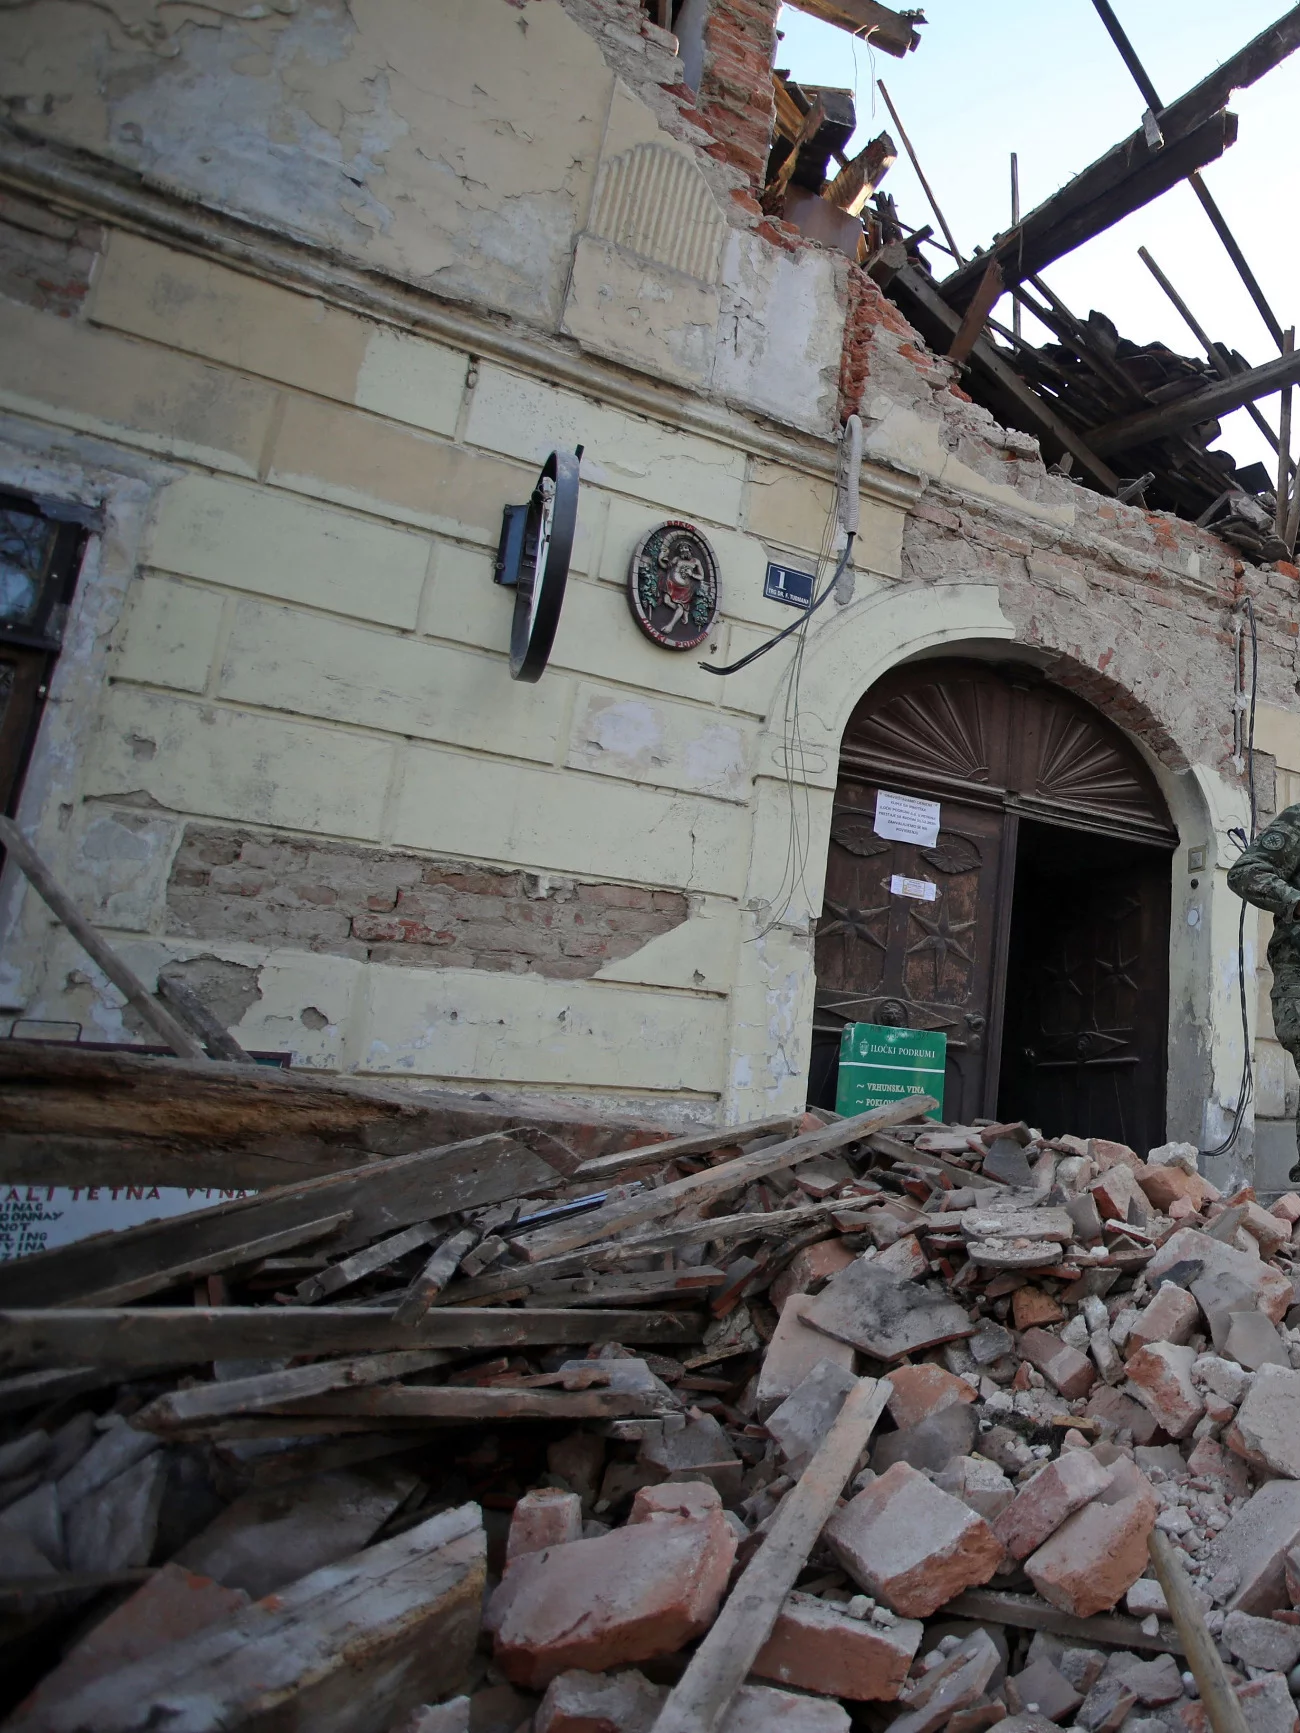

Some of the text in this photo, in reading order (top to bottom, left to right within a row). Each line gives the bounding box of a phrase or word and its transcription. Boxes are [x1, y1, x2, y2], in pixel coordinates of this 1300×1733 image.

[775, 570, 787, 591] 1
[768, 587, 777, 596] TRG
[871, 1044, 936, 1059] ILOČKI PODRUMI
[867, 1082, 925, 1094] VRHUNSKA VINA
